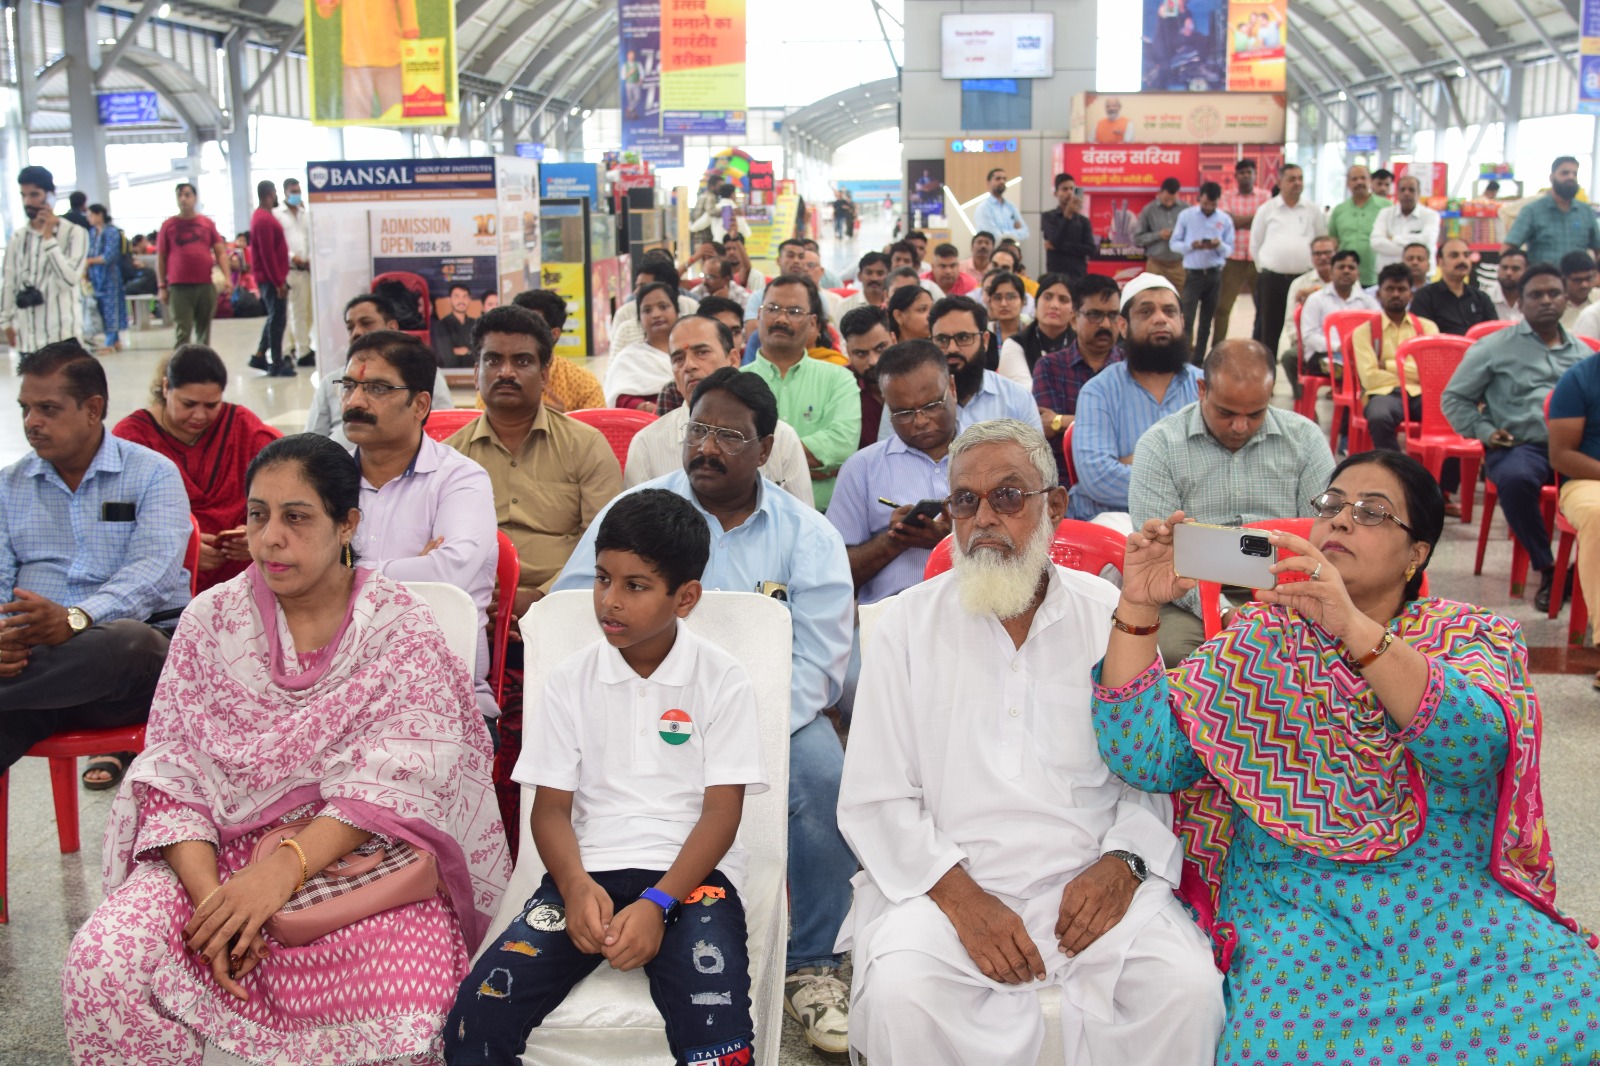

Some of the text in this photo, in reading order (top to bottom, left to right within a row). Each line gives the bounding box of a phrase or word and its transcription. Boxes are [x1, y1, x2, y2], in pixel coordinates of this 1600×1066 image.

[672, 14, 710, 30] मनाने
[714, 18, 732, 30] का
[672, 51, 712, 67] तरीका
[1081, 146, 1181, 164] बंसल सरिया
[330, 166, 413, 186] BANSAL
[414, 165, 440, 173] GROUP
[451, 164, 493, 173] INSTITUTES
[381, 217, 450, 235] ADMISSION
[381, 237, 451, 254] OPEN 2024-25
[692, 1042, 741, 1061] ITALIAN
